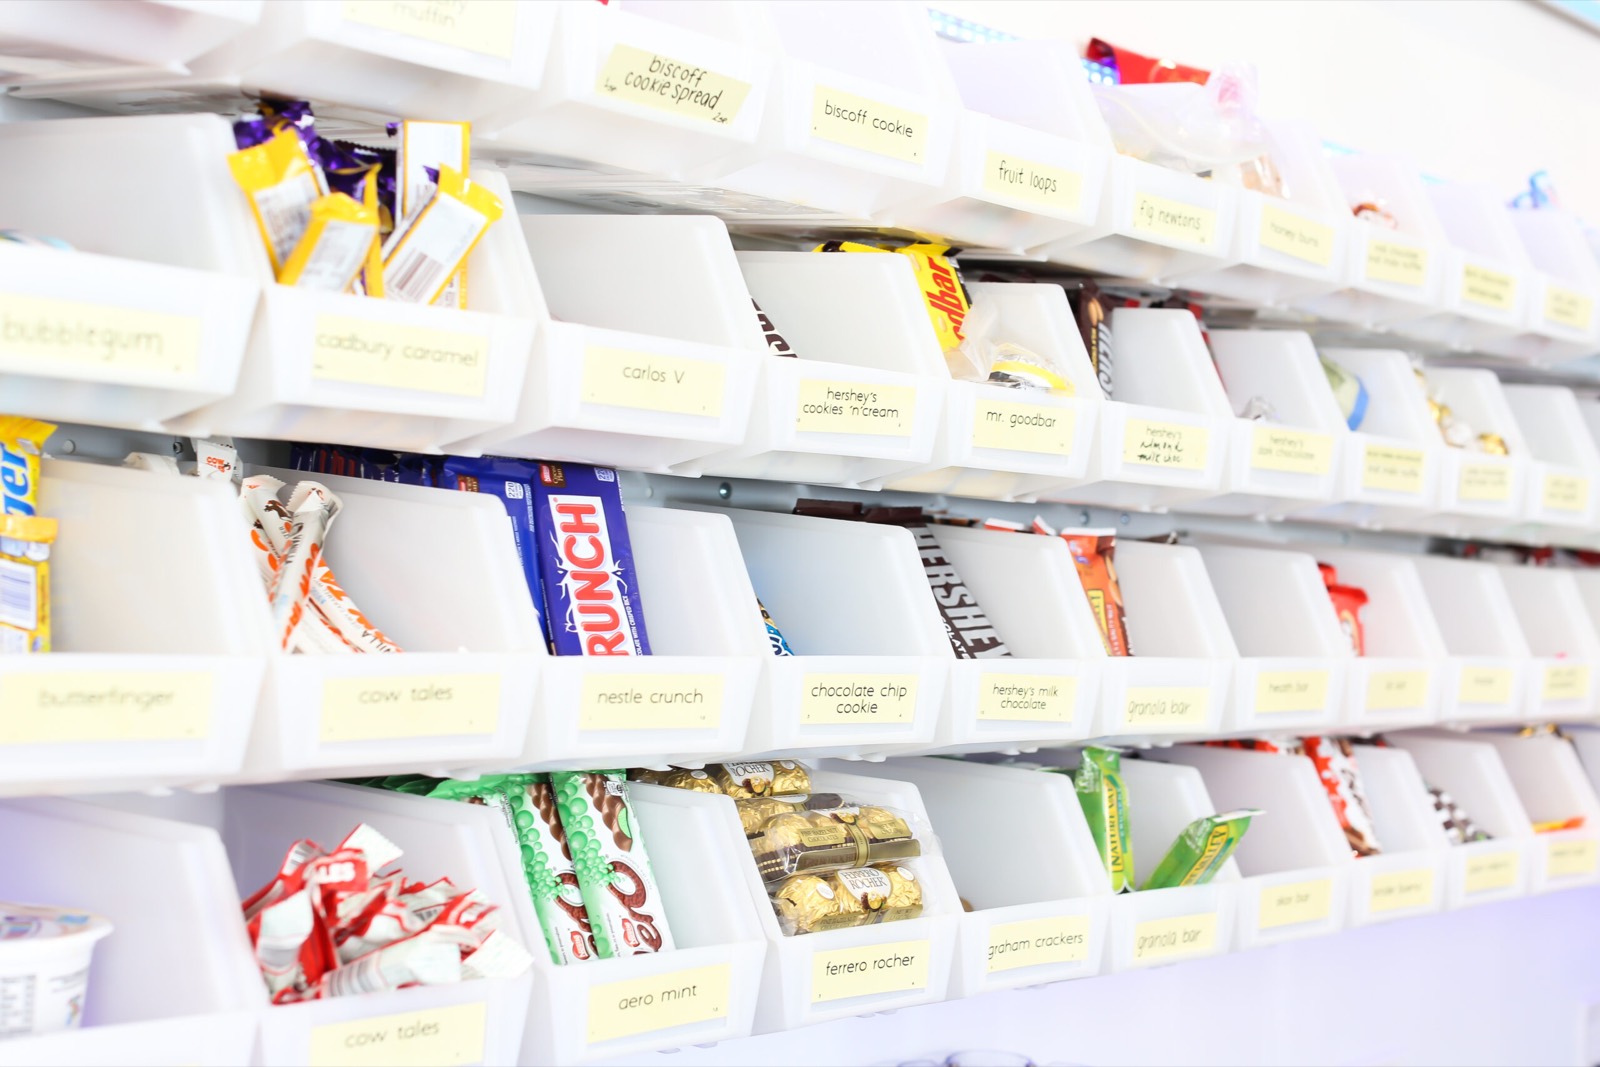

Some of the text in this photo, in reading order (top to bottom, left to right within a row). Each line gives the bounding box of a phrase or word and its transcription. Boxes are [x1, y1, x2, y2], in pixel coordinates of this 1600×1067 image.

[648, 55, 707, 87] biscoff
[624, 71, 671, 96] cookie
[671, 83, 724, 110] spread
[824, 100, 913, 138] biscoff cookie
[999, 160, 1057, 195] fruit loops
[1140, 200, 1201, 231] fig newtons
[2, 312, 164, 362] bubblegum
[316, 333, 479, 367] cadbury caramel
[622, 365, 685, 384] carlos V
[802, 401, 844, 415] cookies
[826, 387, 877, 406] hershey's
[986, 411, 1056, 428] mr. goodbar
[358, 684, 453, 705] cow tales
[597, 688, 704, 704] nestle crunch
[811, 682, 907, 701] chocolate chip
[992, 683, 1059, 699] hershey's milk
[836, 699, 878, 714] cookie
[1000, 697, 1047, 710] chocolate
[1128, 699, 1191, 723] granola bar
[840, 868, 880, 880] FERRERO
[849, 876, 888, 889] ROCHER
[606, 860, 663, 956] ero
[988, 932, 1083, 960] graham crackers
[1137, 928, 1202, 957] granola bar
[826, 953, 915, 976] ferrero rocher
[618, 985, 697, 1010] aero mint
[344, 1020, 440, 1049] cow tales
